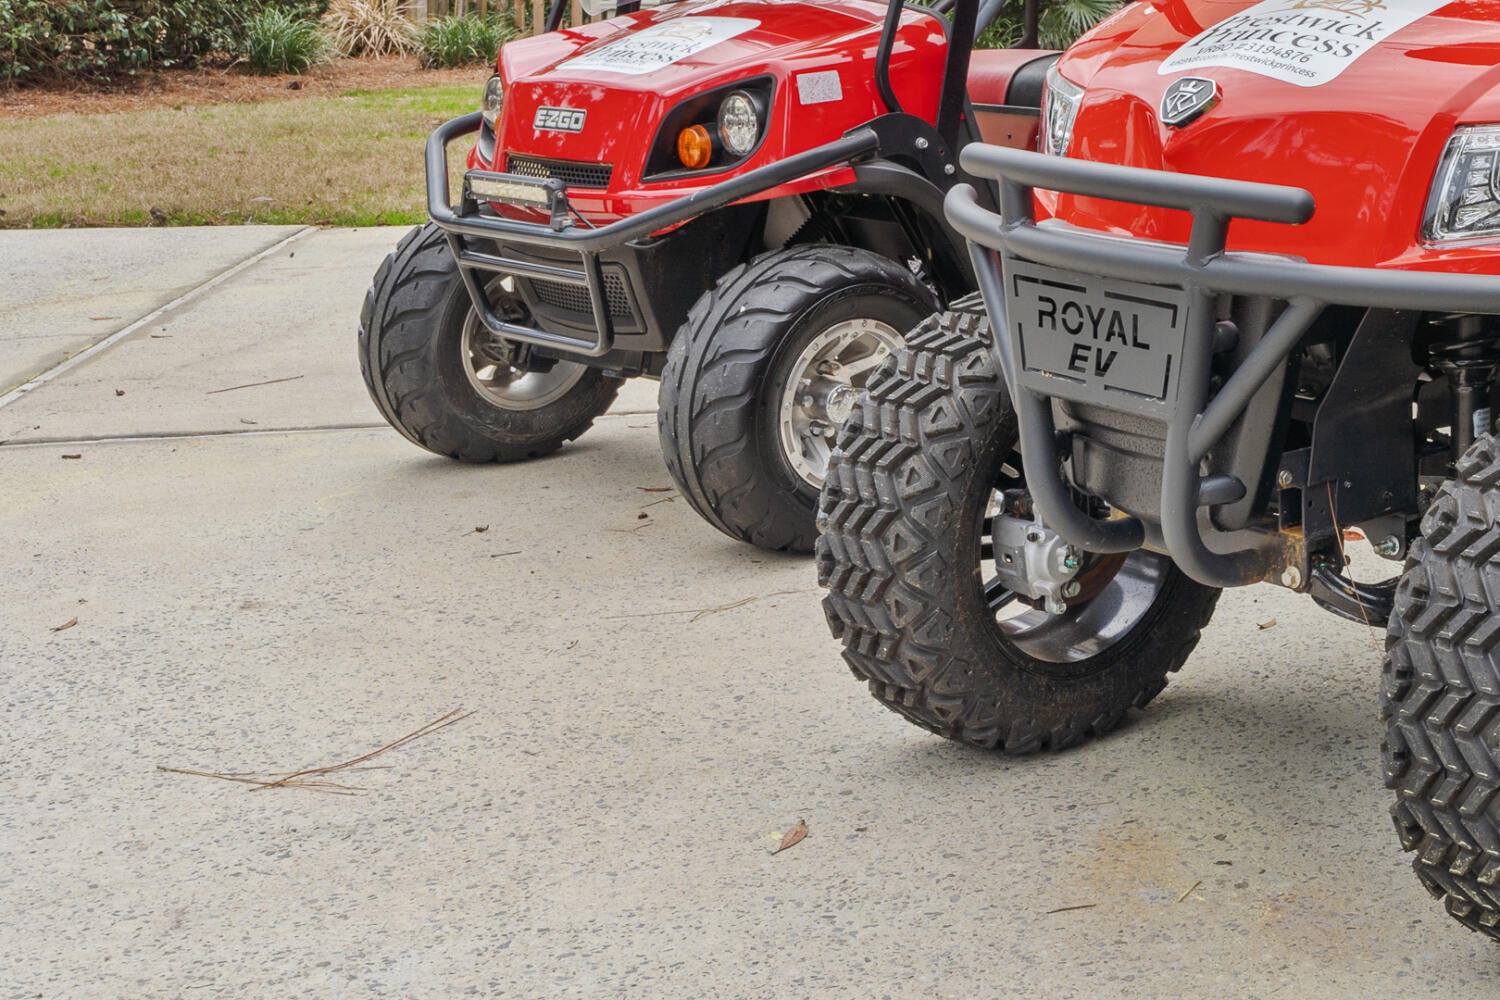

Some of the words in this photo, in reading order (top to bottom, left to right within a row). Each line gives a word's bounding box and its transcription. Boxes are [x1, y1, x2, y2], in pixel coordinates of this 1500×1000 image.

[1213, 12, 1383, 40] Prestwick
[1189, 28, 1359, 58] Princess
[1038, 295, 1150, 350] ROYAL
[1067, 342, 1118, 378] EV
